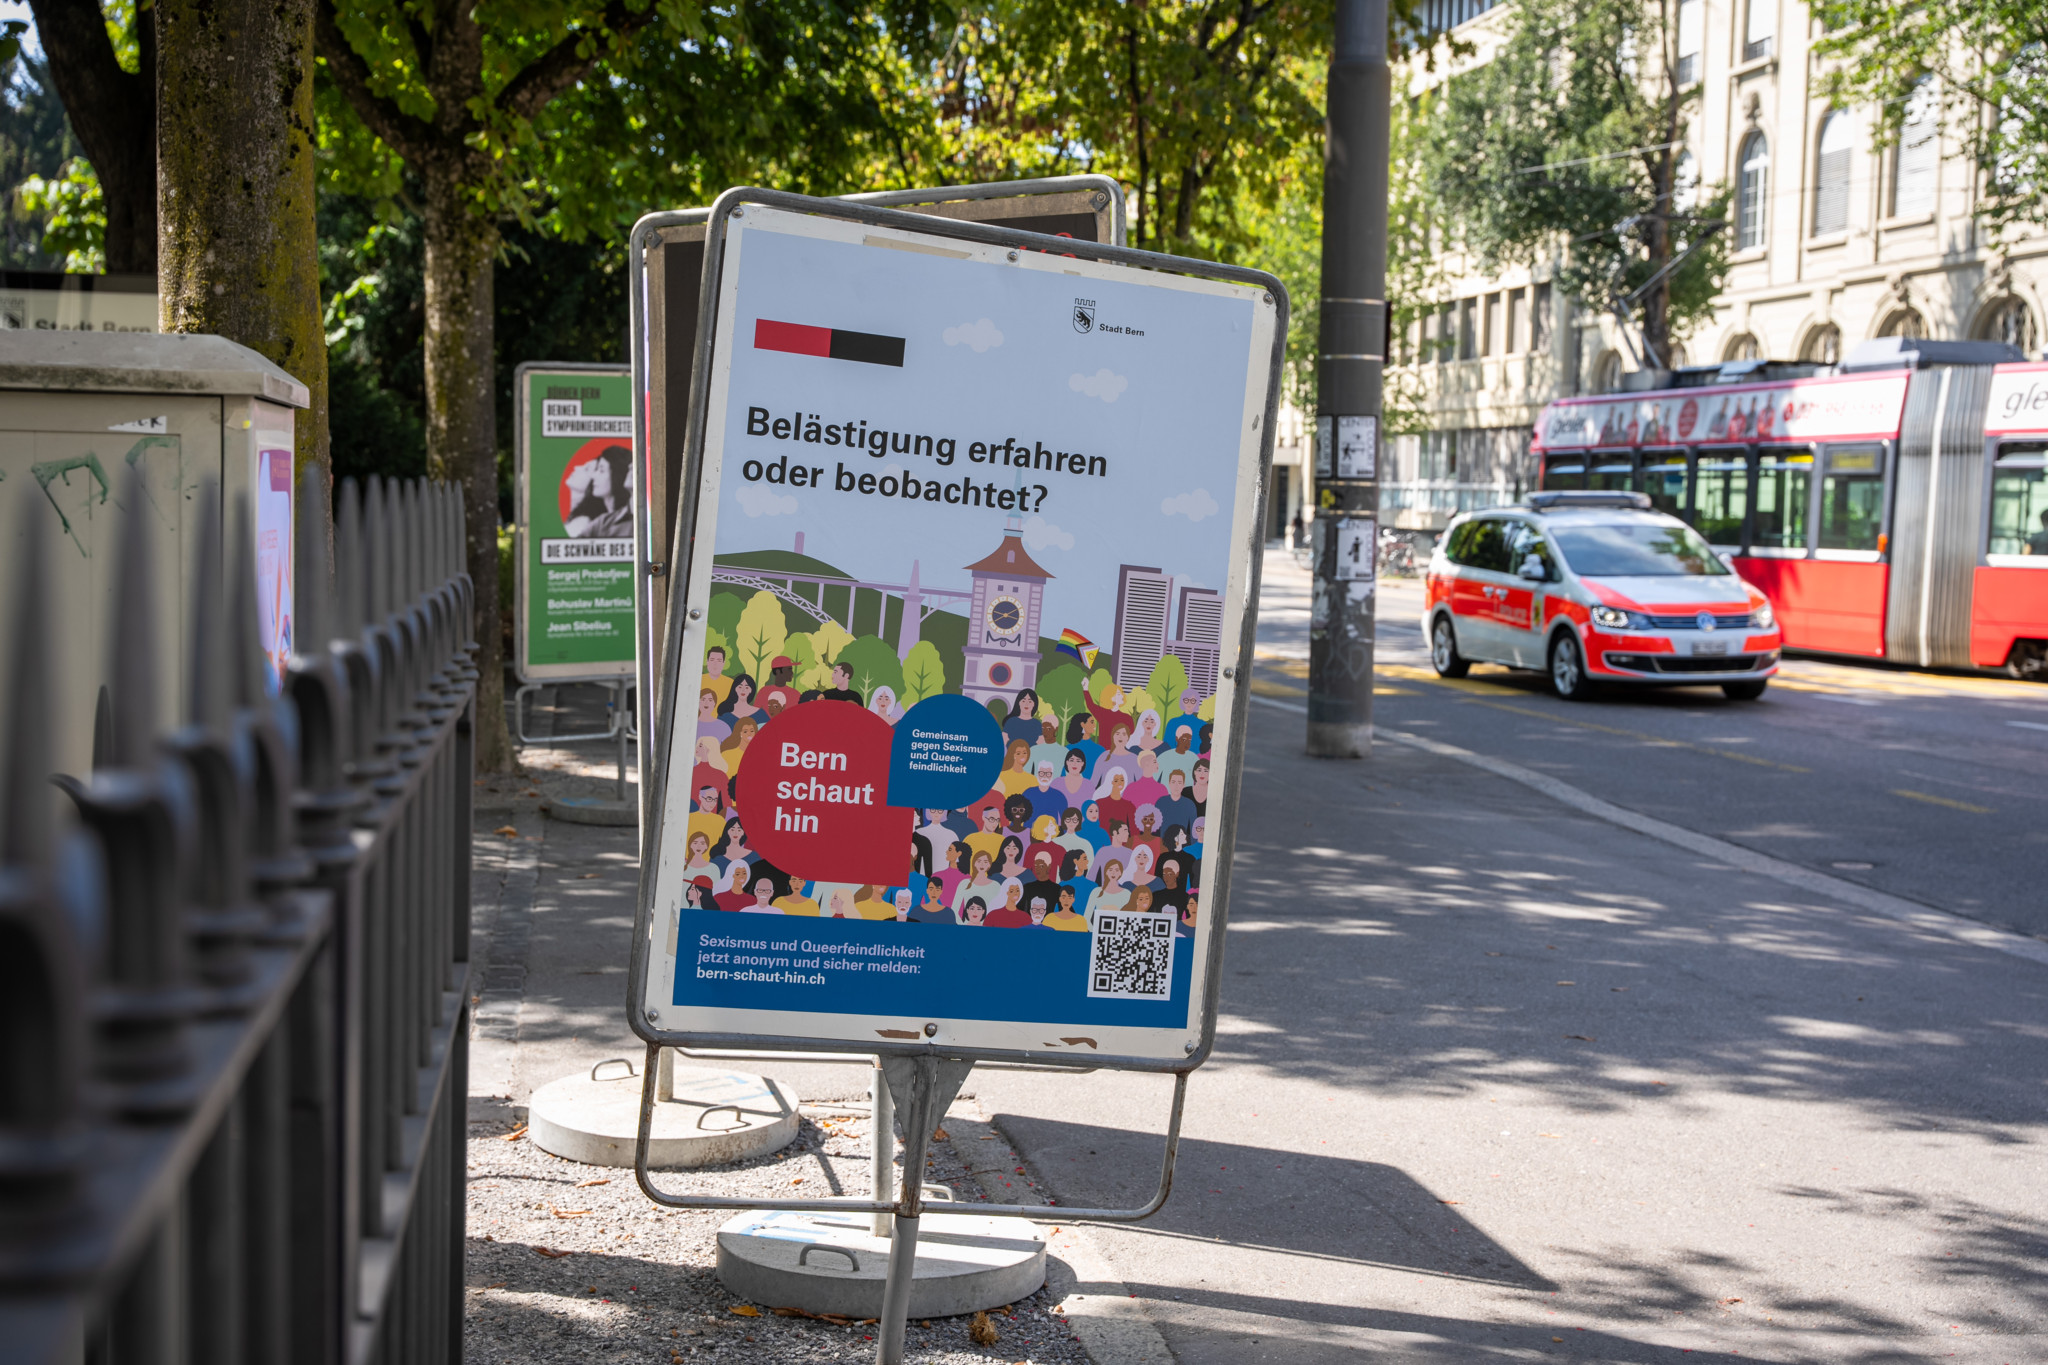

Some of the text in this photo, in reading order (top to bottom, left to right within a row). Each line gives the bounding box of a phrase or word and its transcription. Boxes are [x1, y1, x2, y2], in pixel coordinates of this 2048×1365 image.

[1099, 323, 1145, 337] Stadt Bern
[547, 404, 577, 416] BERNER
[747, 406, 1107, 477] Belästigung erfahren
[742, 455, 1048, 513] oder beobachtet?
[547, 544, 561, 558] DIE
[564, 542, 606, 557] SCHWÄNE
[610, 543, 625, 556] DES
[547, 568, 631, 582] Sergej Prokofjew
[547, 598, 593, 610] Bohuslav
[547, 622, 572, 634] Jean
[573, 620, 612, 631] Sibelius
[912, 728, 969, 742] Gemeinsam
[911, 741, 988, 754] gegen Sexismus
[780, 742, 848, 772] Bern
[910, 751, 963, 762] und Queer-
[909, 761, 967, 774] feindlichkeit
[776, 776, 875, 806] schaut
[774, 806, 819, 834] hin
[699, 934, 926, 959] Sexismus und Queerfeindlichkeit
[696, 950, 922, 974] jetzt anonym und sicher melden:
[696, 966, 826, 985] bern-schaut-hin.ch
